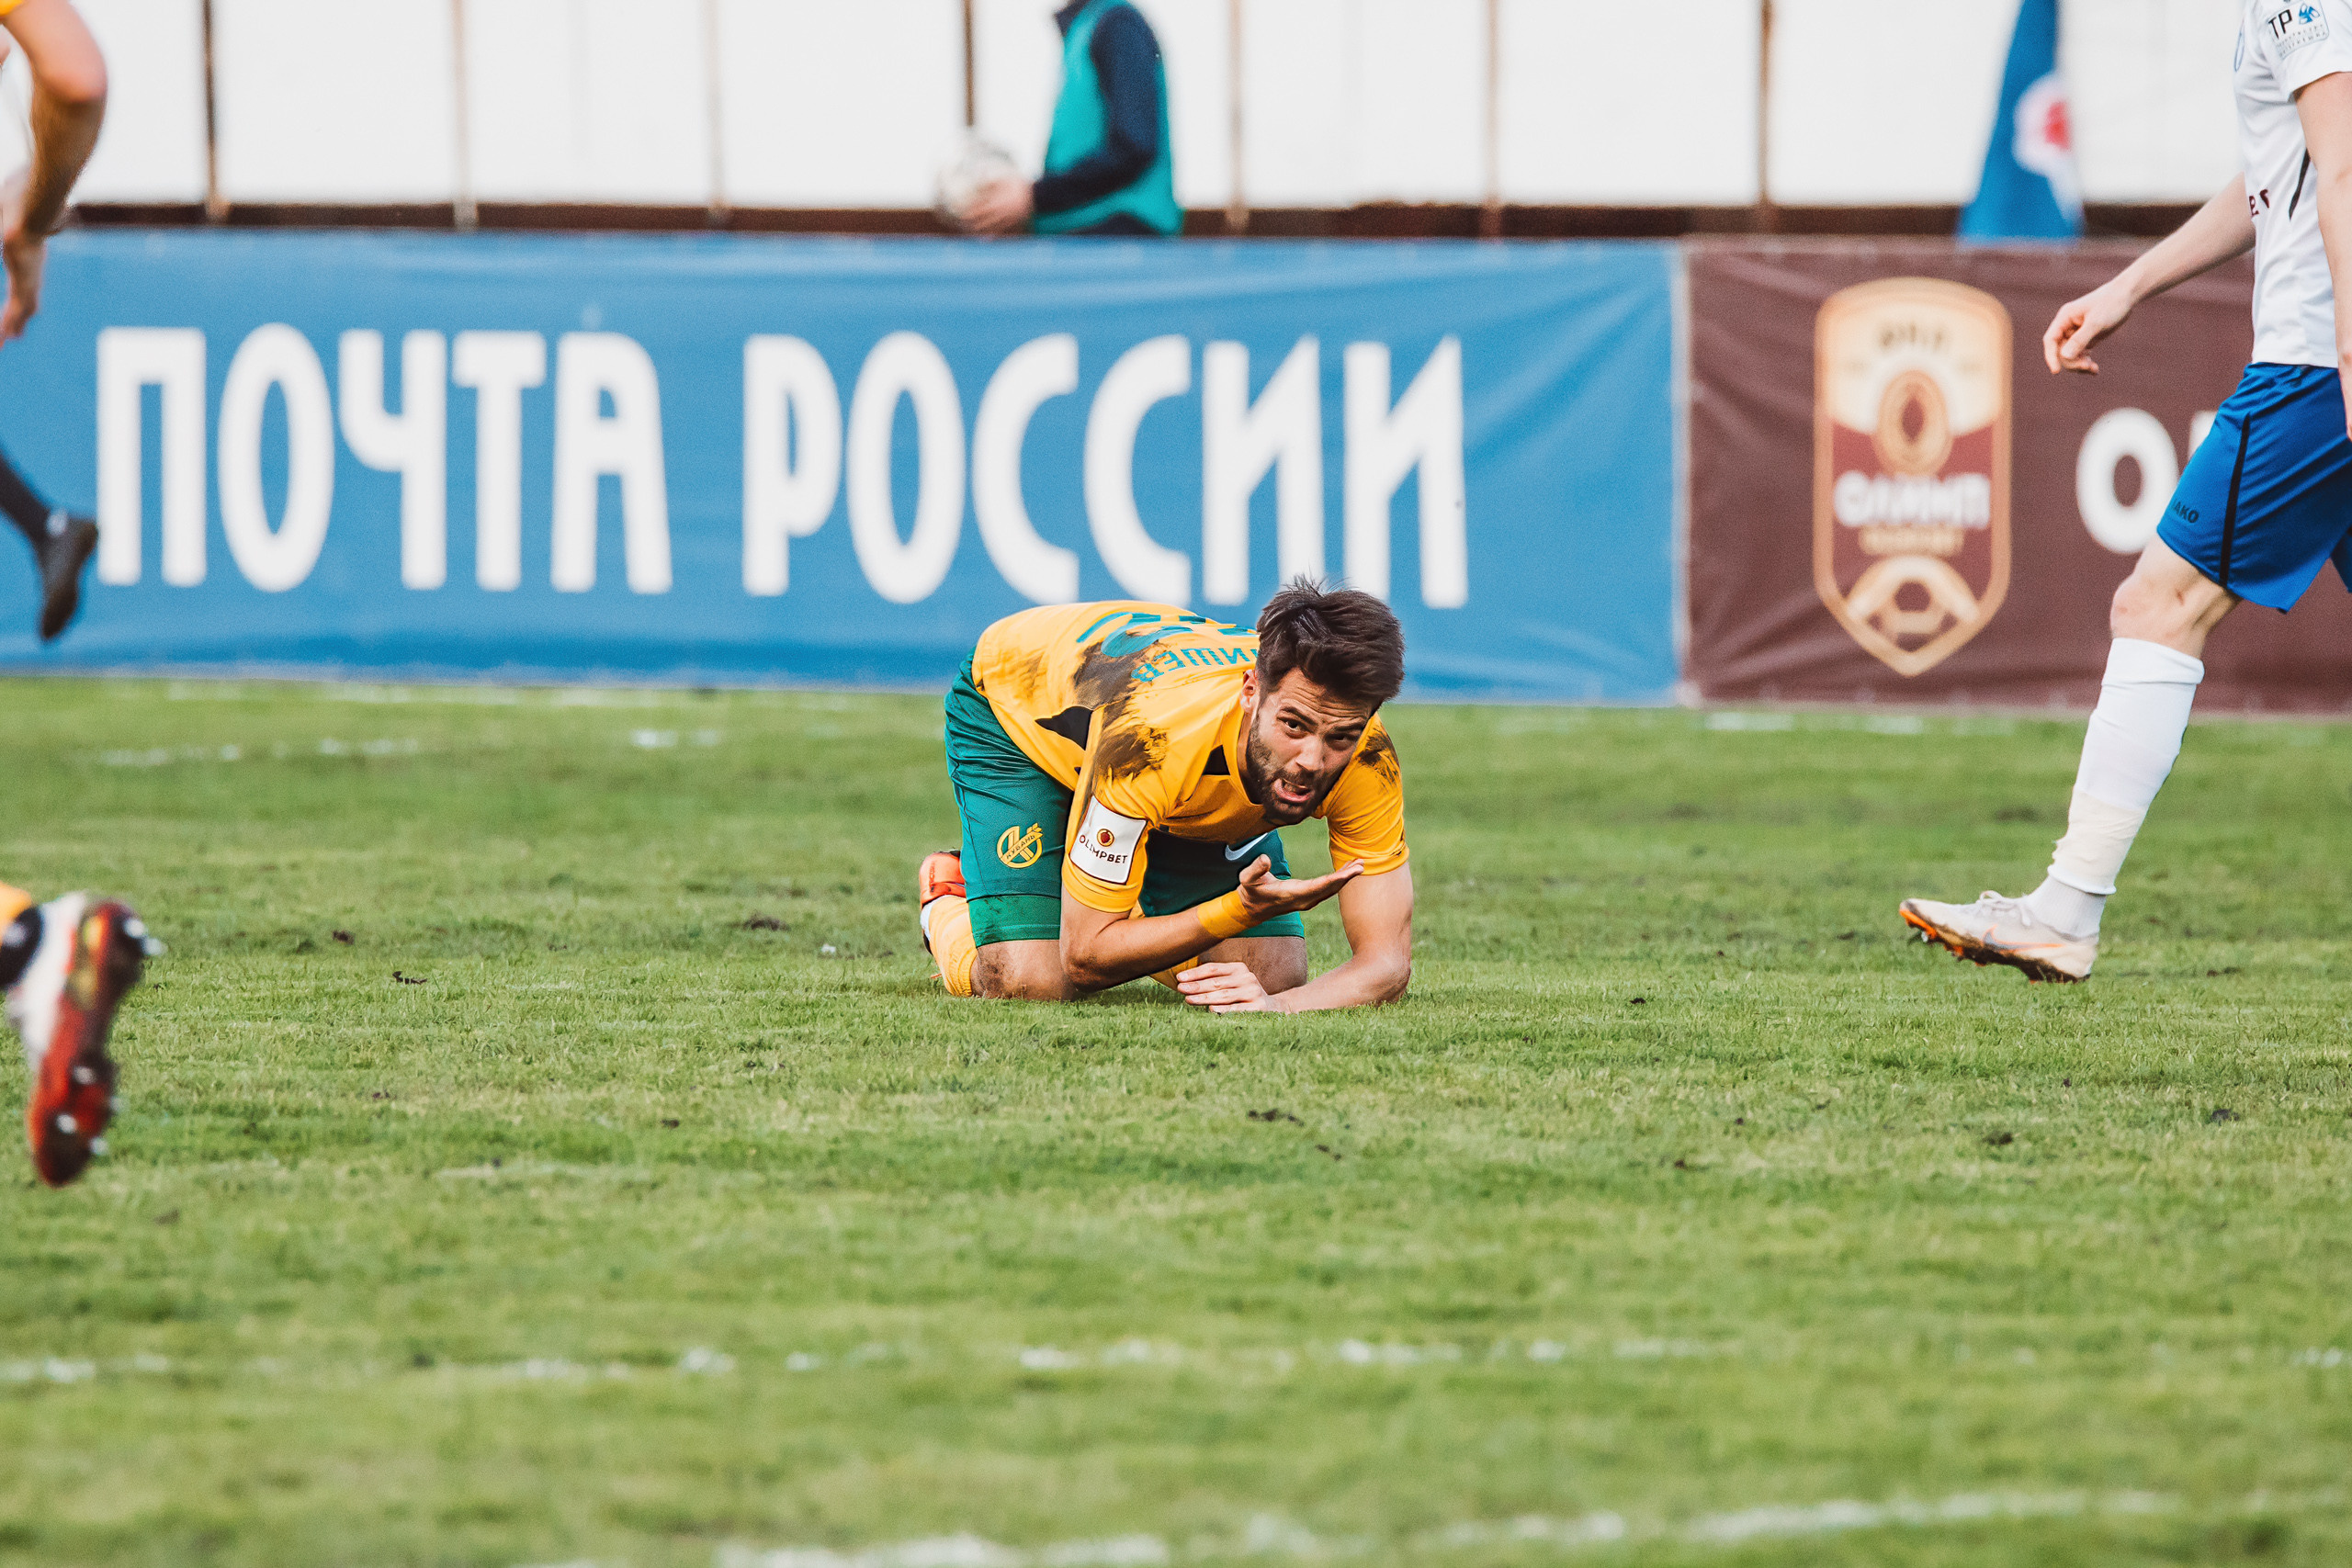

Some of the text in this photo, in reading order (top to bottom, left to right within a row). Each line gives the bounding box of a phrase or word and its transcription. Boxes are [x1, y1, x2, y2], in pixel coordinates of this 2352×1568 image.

[96, 322, 1468, 608] ПОЧТА РОССИИ
[1131, 647, 1259, 682] ИШЕВ
[1079, 834, 1128, 864] OLIMPBET
